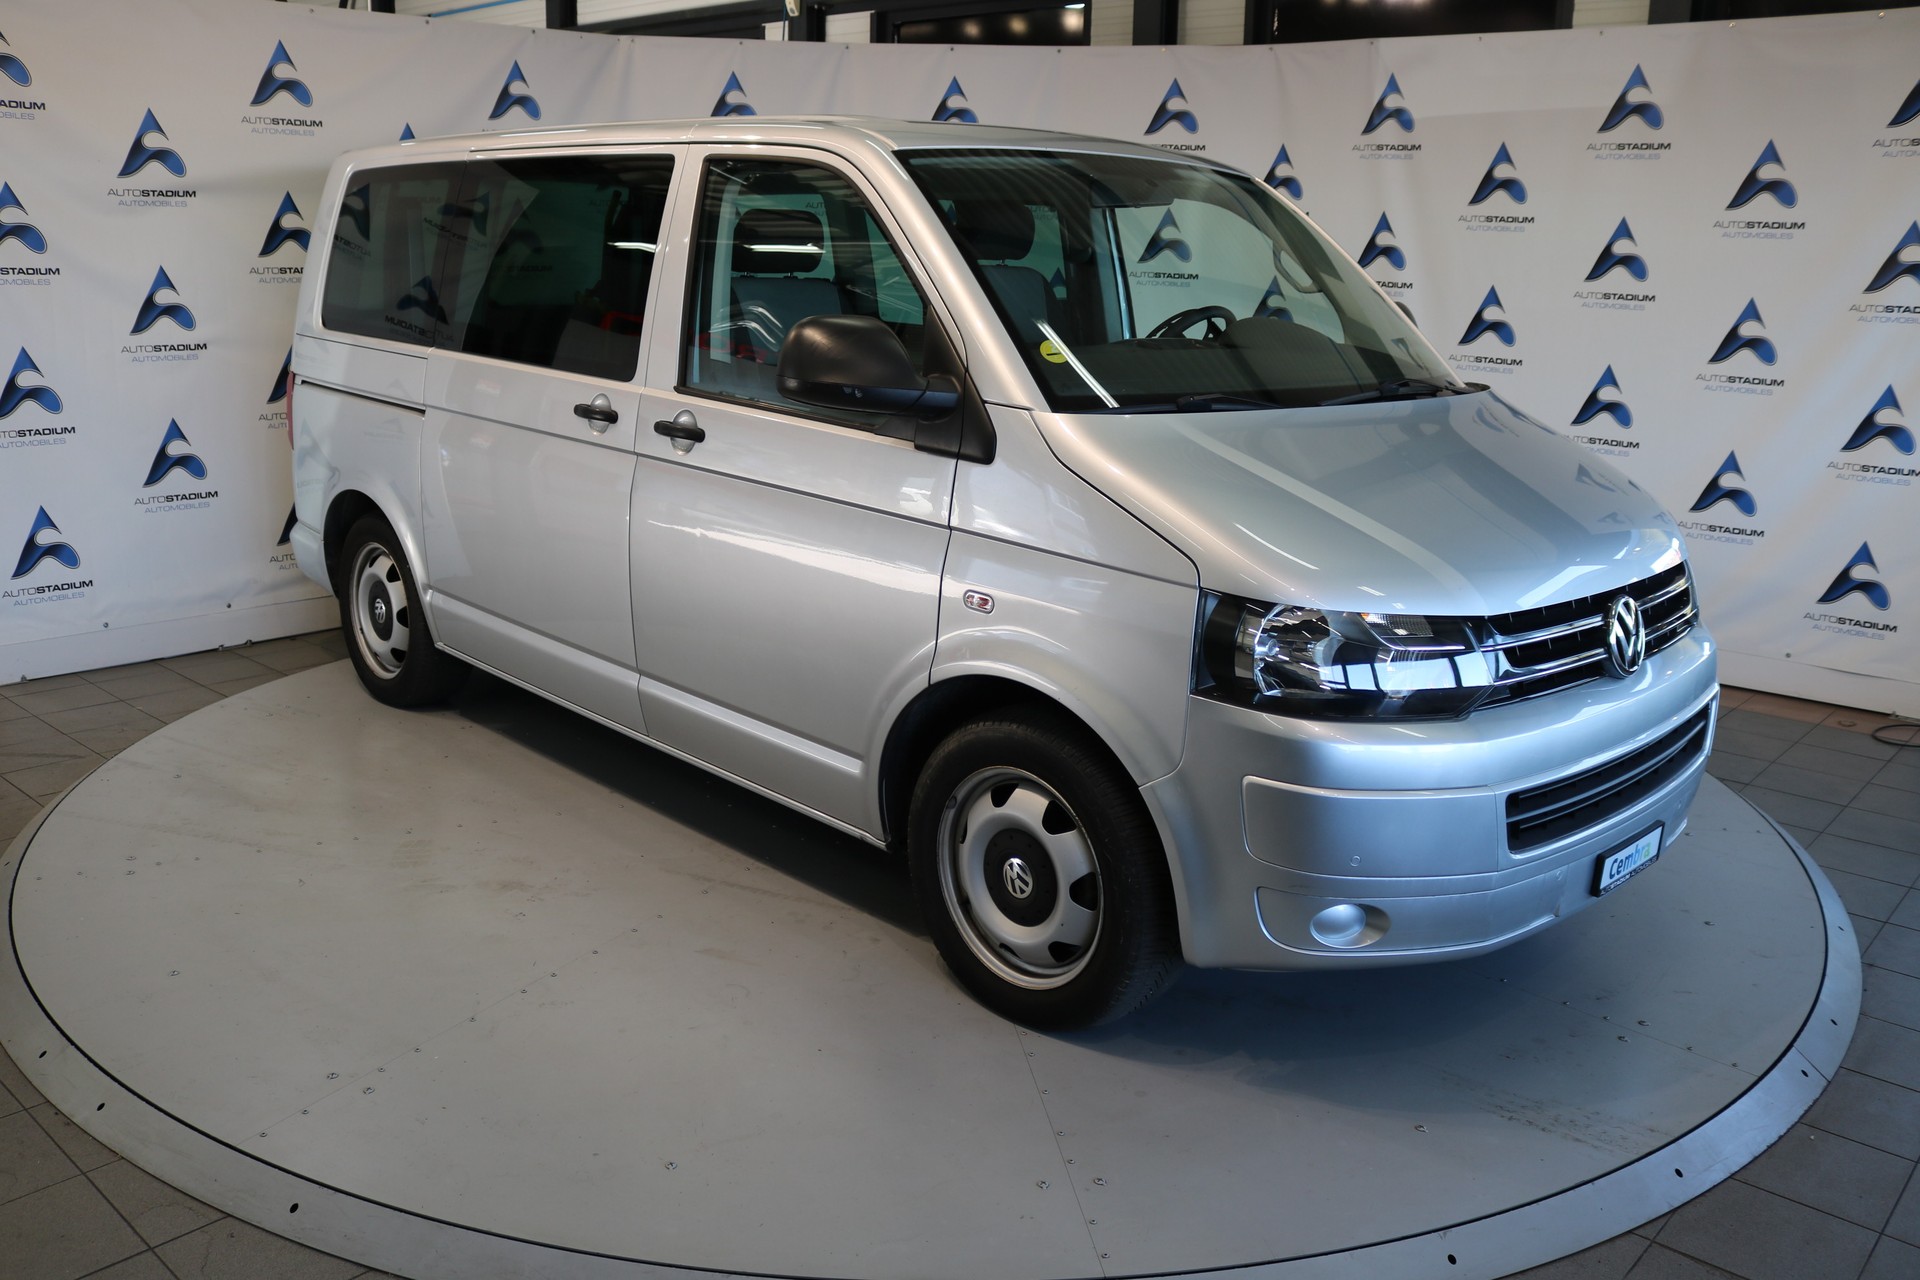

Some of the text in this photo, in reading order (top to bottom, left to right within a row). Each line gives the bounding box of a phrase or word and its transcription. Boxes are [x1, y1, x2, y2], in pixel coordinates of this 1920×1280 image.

[241, 115, 323, 128] AUTOSTADIUM
[251, 127, 315, 137] AUTOMOBILES
[1351, 143, 1422, 152] AUTOSTADIUM
[1586, 142, 1672, 151] AUTOSTADIUM
[1594, 152, 1661, 161] AUTOMOBILES
[107, 188, 197, 198] AUTOSTADIUM
[118, 199, 188, 208] AUTOMOBILES
[1457, 214, 1535, 224] AUTOSTADIUM
[1466, 225, 1525, 233] AUTOMOBILES
[1713, 220, 1806, 230] AUTOSTADIUM
[1721, 231, 1794, 240] AUTOMOBILES
[0, 267, 61, 276] STADIUM
[249, 266, 304, 275] AUTOSTA
[1129, 270, 1199, 280] AUTOSTADIUM
[0, 278, 51, 286] OMOBILES
[1136, 280, 1191, 288] AUTOMOBILES
[1376, 280, 1413, 290] TADIUM
[1573, 290, 1656, 302] AUTOSTADIUM
[1581, 301, 1646, 311] AUTOMOBILES
[1849, 304, 1920, 314] AUTOSTAD
[1857, 315, 1920, 325] AUTOMOBIL
[120, 343, 208, 355] AUTOSTADIUM
[131, 353, 199, 364] AUTOMOBILES
[1449, 353, 1523, 366] AUTOSTADIUM
[1456, 364, 1514, 374] AUTOMOBILES
[1695, 373, 1785, 387] AUTOSTADIUM
[1704, 384, 1773, 396] AUTOMOBILES
[0, 426, 76, 439] TOSTADIUM
[1835, 472, 1911, 487] AUTOMOBILES
[134, 490, 219, 506] AUTOSTADIUM
[144, 501, 210, 514] AUTOMOBILES
[1678, 520, 1765, 537] AUTOSTADIUM
[1685, 531, 1754, 546] AUTOMOBILES
[1, 579, 94, 599] AUTOSTADIUM
[13, 591, 85, 607] AUTOMOBILES
[1803, 612, 1898, 633] AUTOSTADIUM
[1812, 623, 1885, 641] AUTOMOBILES
[1609, 842, 1652, 880] Cembra
